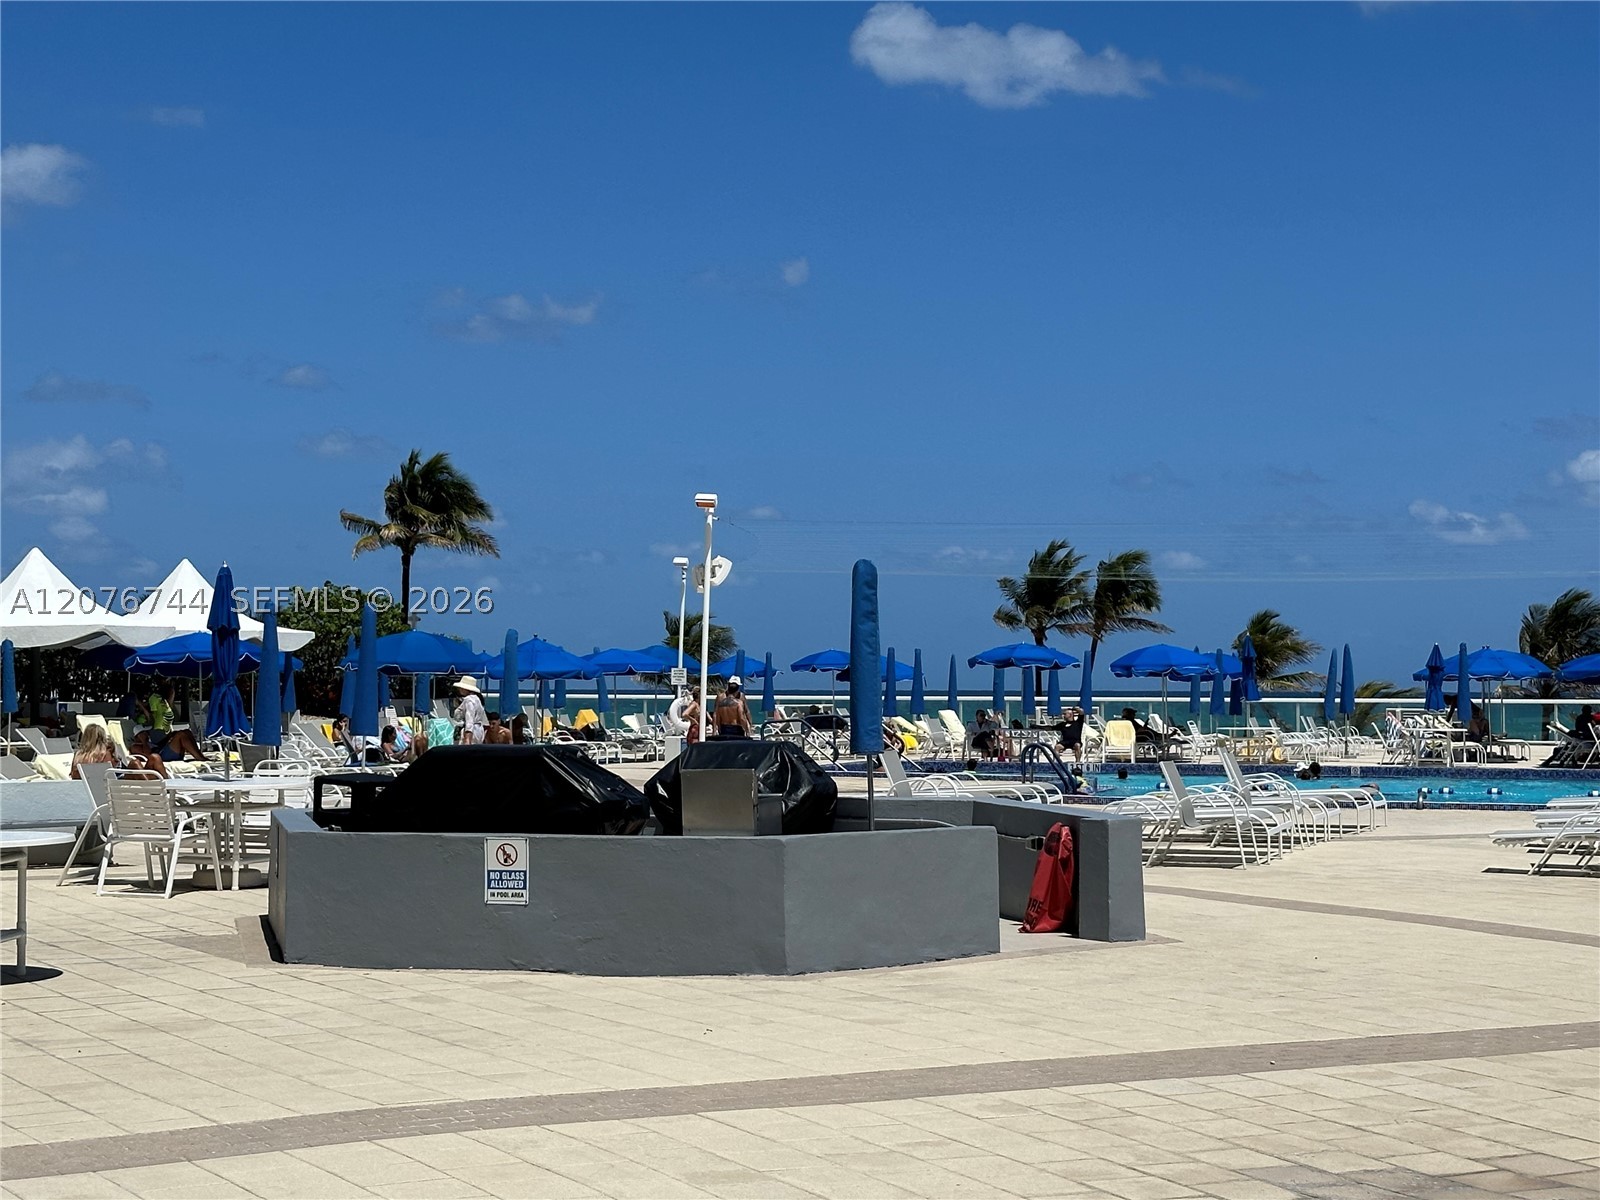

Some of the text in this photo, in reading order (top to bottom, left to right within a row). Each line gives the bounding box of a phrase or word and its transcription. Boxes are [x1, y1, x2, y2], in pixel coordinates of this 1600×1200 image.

[1086, 764, 1091, 772] 6
[1092, 764, 1100, 772] IN
[502, 872, 525, 880] GLASS
[490, 880, 524, 888] ALLOWED
